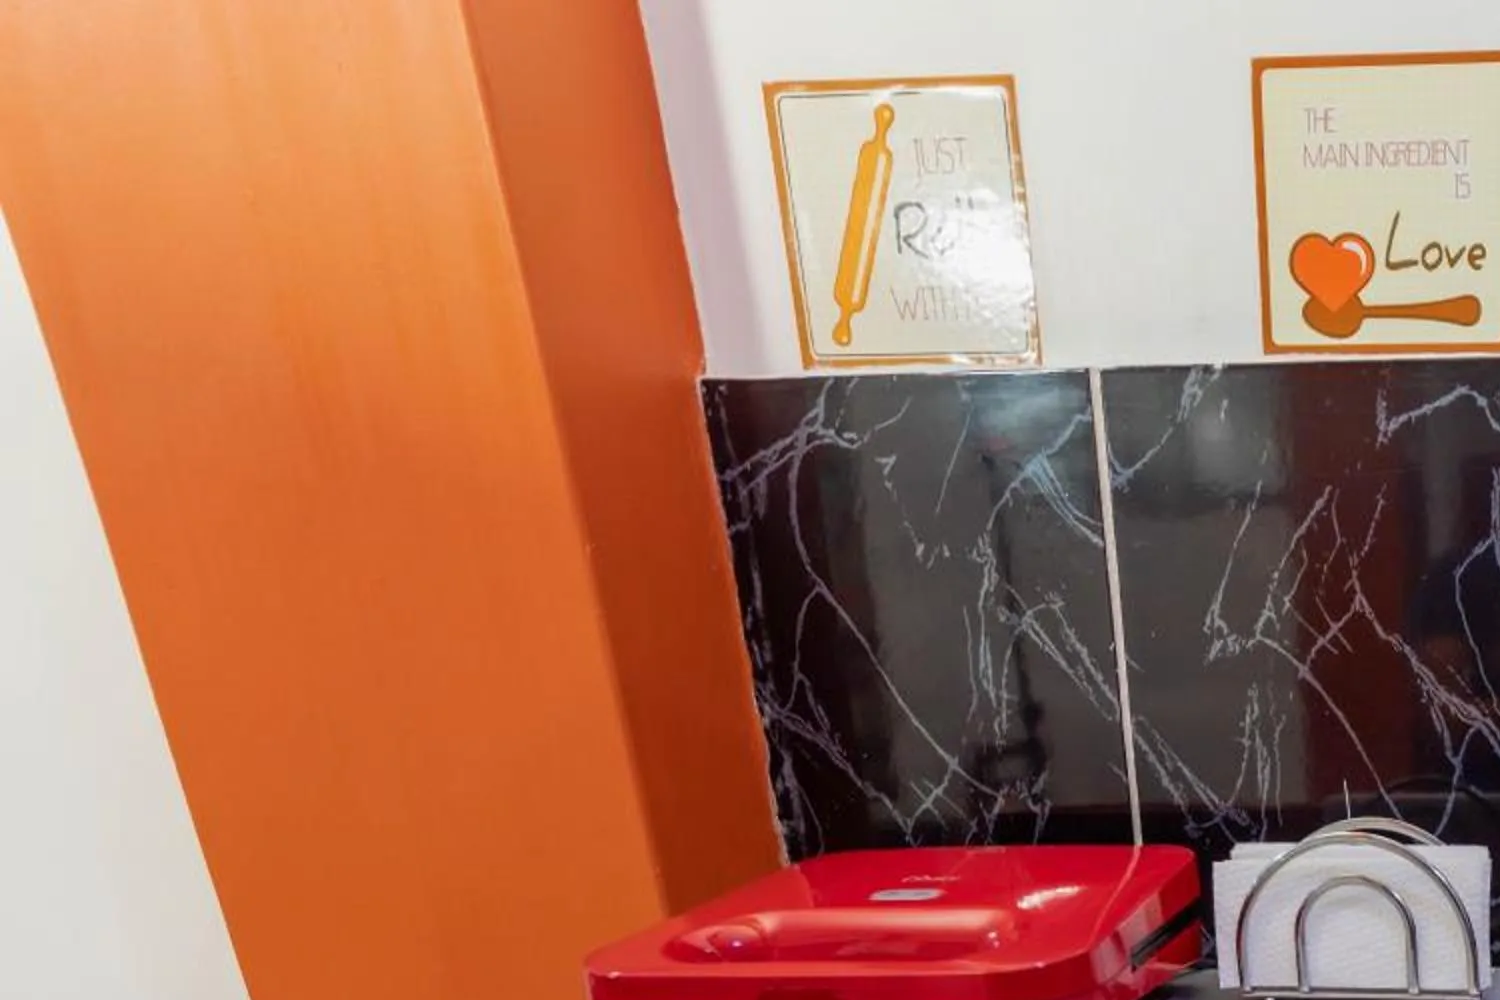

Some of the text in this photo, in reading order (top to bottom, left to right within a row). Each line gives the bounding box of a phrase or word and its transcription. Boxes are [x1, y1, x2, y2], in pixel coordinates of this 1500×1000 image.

[1303, 107, 1338, 134] THE
[913, 136, 967, 176] JUST
[1303, 138, 1471, 168] MAIN INGREDIENT
[1454, 172, 1472, 199] IS
[1384, 210, 1487, 272] Love
